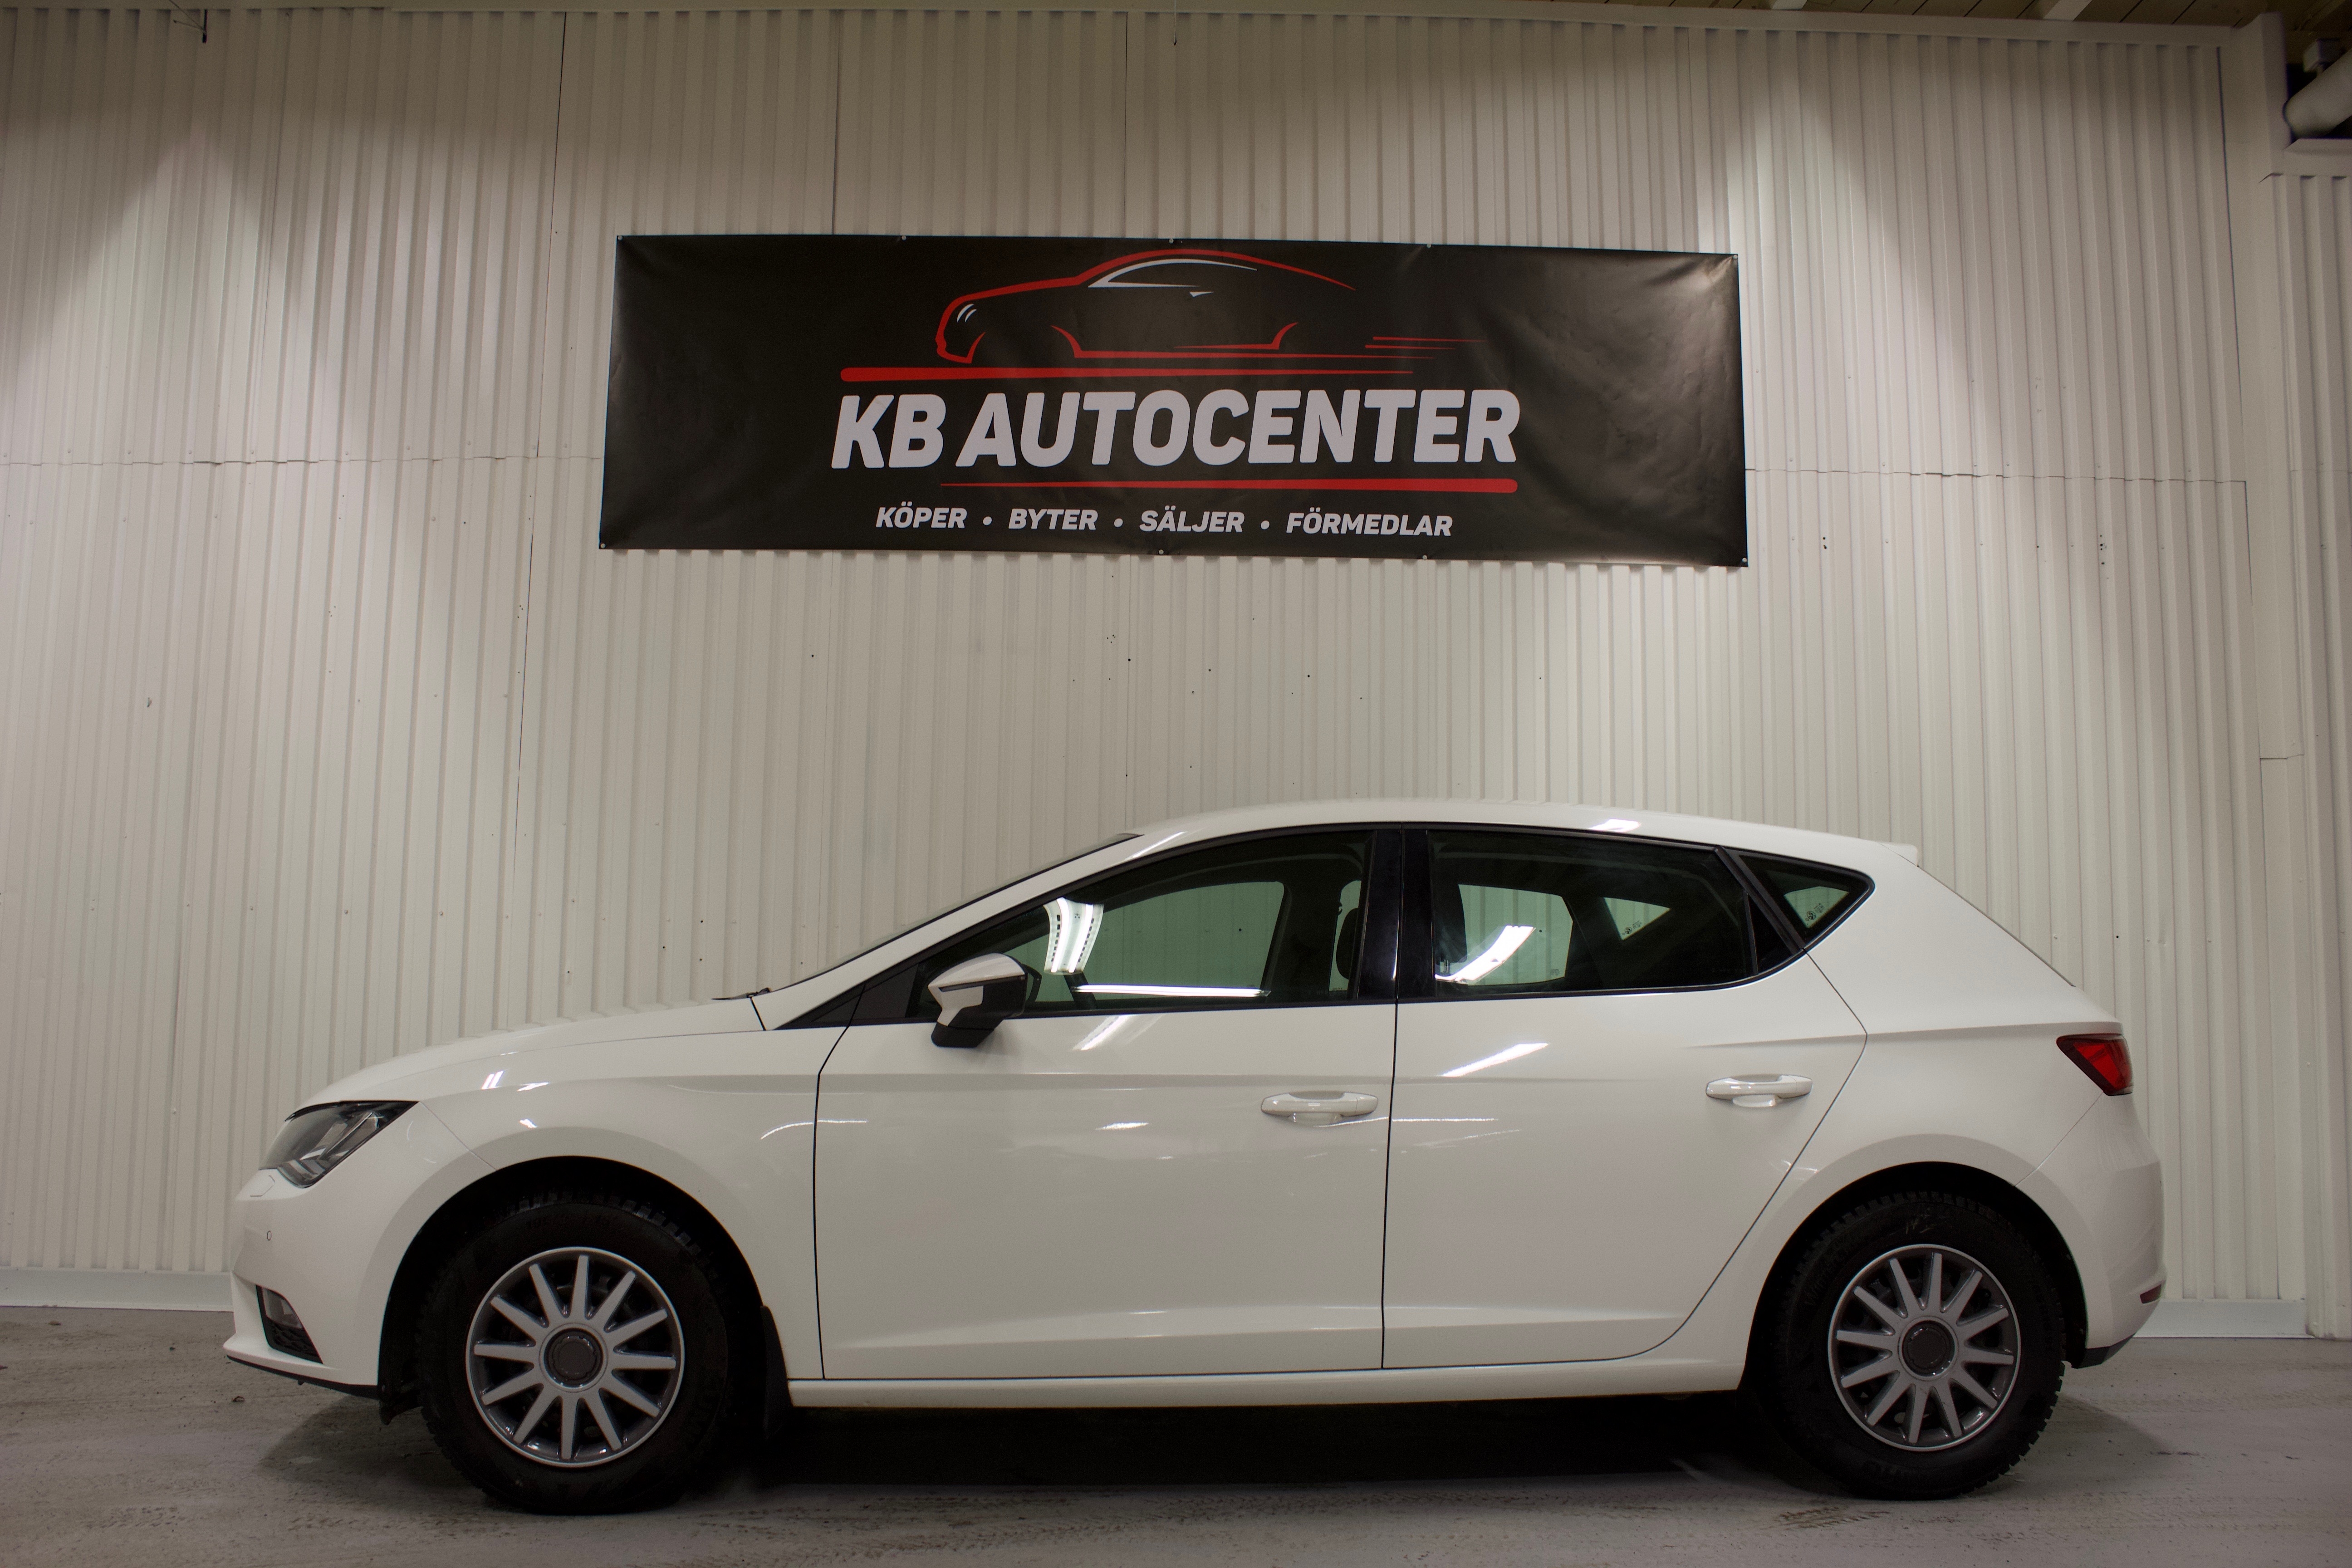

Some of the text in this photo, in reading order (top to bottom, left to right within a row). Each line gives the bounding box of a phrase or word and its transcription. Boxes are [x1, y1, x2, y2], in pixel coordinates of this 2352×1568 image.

[832, 390, 1519, 468] KB AUTOCENTER
[876, 502, 1453, 536] KÖPER BYTER SÄLJER FÖRMEDLAR
